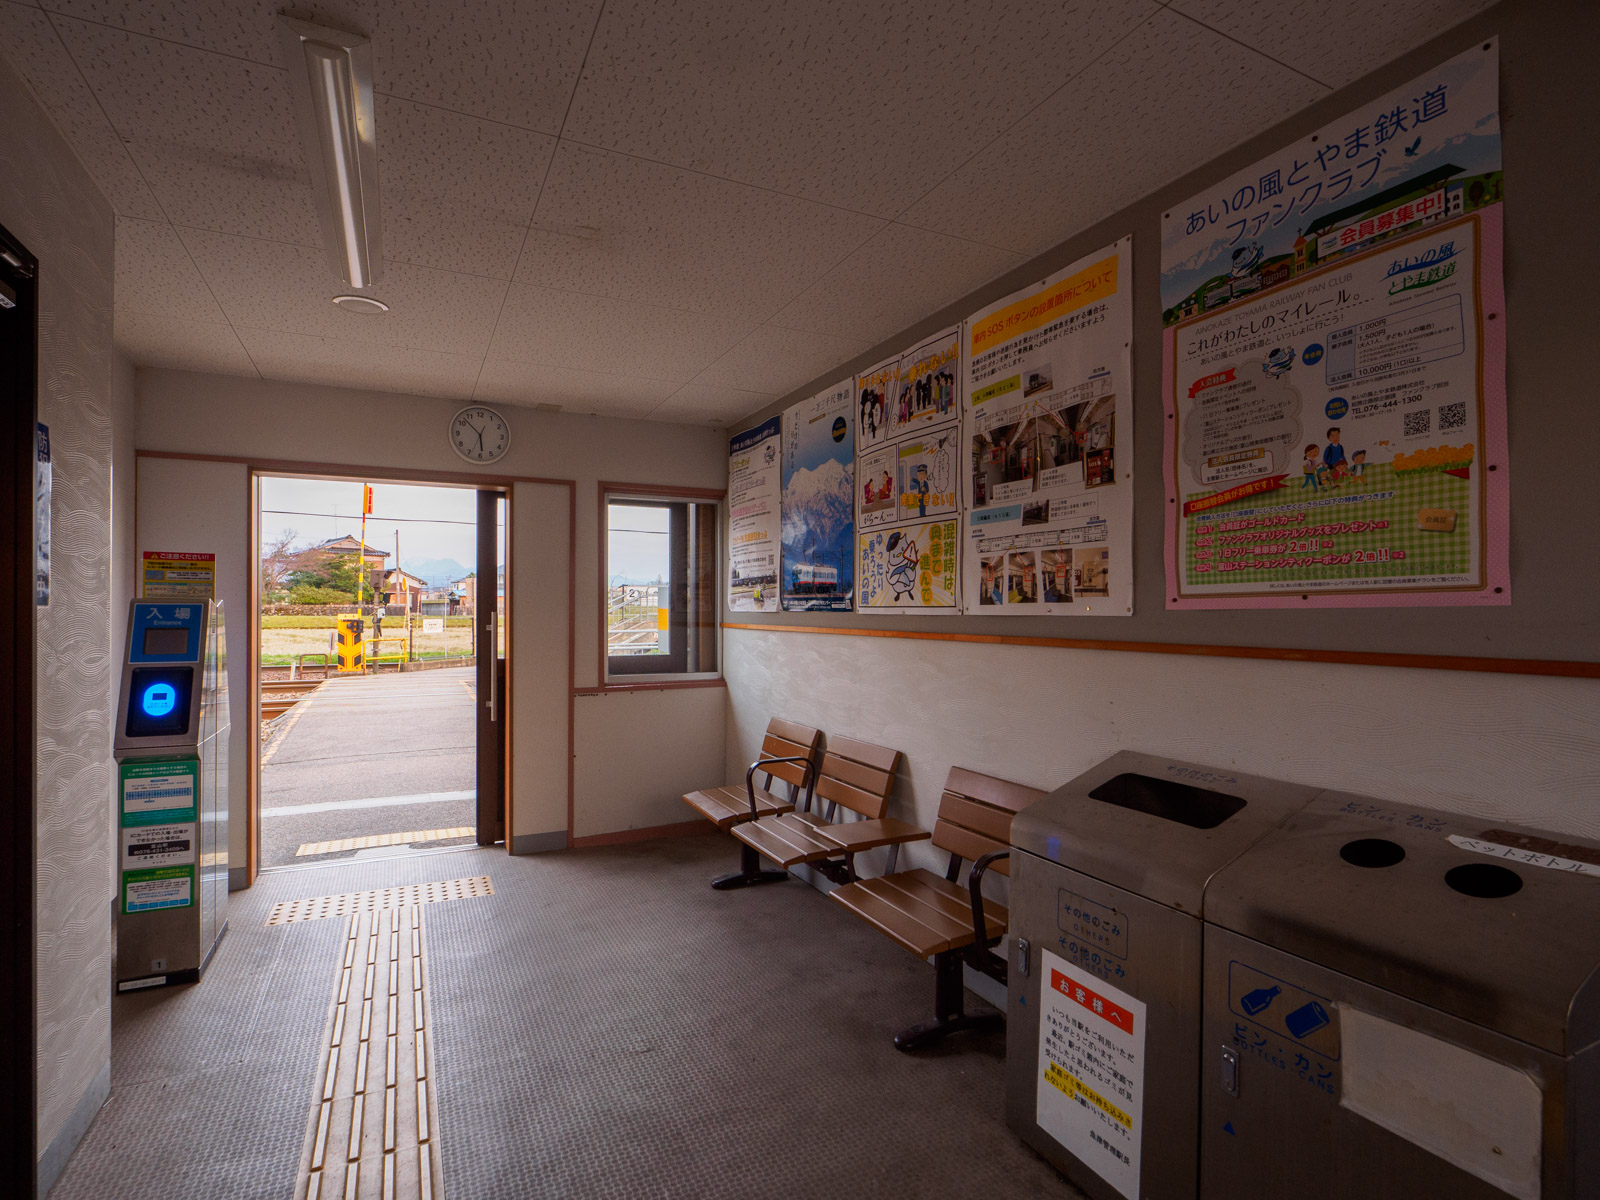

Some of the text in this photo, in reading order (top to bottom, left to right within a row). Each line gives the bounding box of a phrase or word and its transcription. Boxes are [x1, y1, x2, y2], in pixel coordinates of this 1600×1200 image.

[1185, 84, 1449, 237] あいの風とやま鉄道
[1225, 149, 1388, 247] ファンクラブ
[1339, 192, 1443, 248] 会員募集中!
[1387, 240, 1456, 276] あいの風
[1387, 260, 1457, 297] とやま鉄道
[1235, 303, 1268, 321] TOYAMA
[1269, 290, 1306, 309] RAILWAY
[1306, 281, 1327, 296] FAN
[1328, 272, 1354, 288] CLUB
[987, 320, 1004, 337] SOS
[1187, 288, 1361, 355] これがわたしのマイレール。
[1359, 318, 1387, 332] 1,000円
[1359, 328, 1386, 342] 1,500円
[1218, 513, 1305, 532] 会員証がゴールドカード
[930, 525, 942, 574] 奥まで
[943, 522, 955, 596] 混雑時は、
[861, 548, 870, 605] あいの風
[920, 555, 931, 602] 進んで
[146, 607, 191, 620] 入場
[1459, 838, 1589, 872] ペットボトル
[1064, 903, 1121, 937] その他のごみ
[1073, 923, 1111, 946] OTHERS
[1058, 935, 1126, 978] その他のごみ
[1059, 978, 1122, 1024] お客様へ
[1046, 1014, 1117, 1066] きありがとうございます。
[1052, 1005, 1135, 1065] いつも当駅をご利用いただ
[1234, 1022, 1333, 1079] ビン・カン
[1044, 1047, 1084, 1081] 受けられます。
[1045, 1036, 1133, 1103] 発生したと思われるゴミが見
[1044, 1070, 1131, 1141] れないようお願いいたします。
[1050, 1063, 1132, 1128] 家庭ゴミ等はお持ち込みさ
